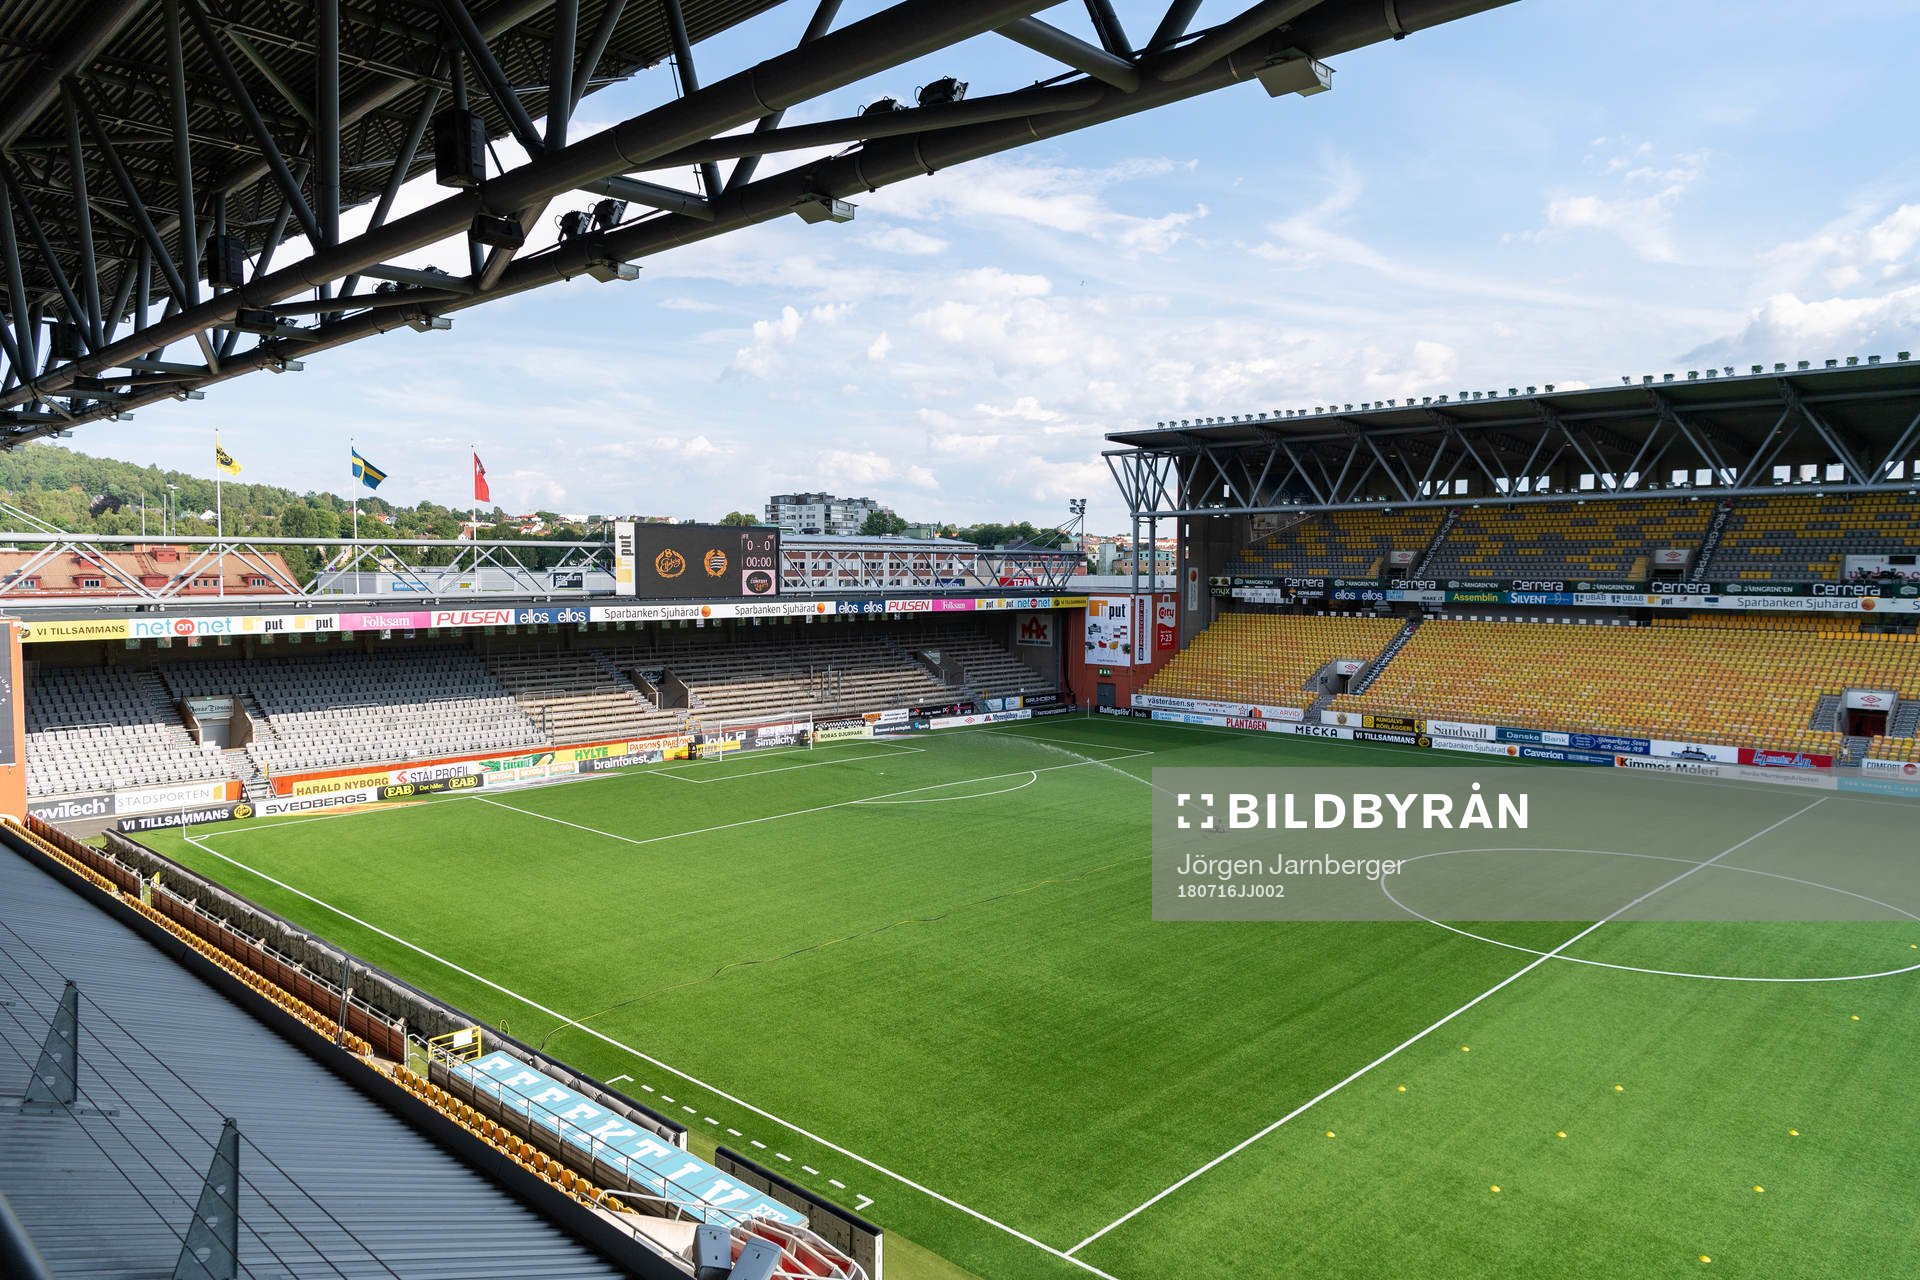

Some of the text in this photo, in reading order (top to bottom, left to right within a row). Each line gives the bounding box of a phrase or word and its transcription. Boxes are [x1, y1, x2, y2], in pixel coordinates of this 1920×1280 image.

[747, 541, 753, 551] 0
[764, 541, 770, 551] 0
[746, 557, 772, 567] 00:00
[1211, 587, 1230, 596] onyx
[1335, 589, 1356, 600] ellos
[1362, 590, 1383, 601] ellos
[1453, 592, 1499, 602] Assemblin
[1510, 592, 1547, 604] SILVENT
[735, 603, 816, 616] Sparbanken Sjuhärad
[838, 600, 883, 614] ellos ellos
[887, 600, 930, 612] PULSEN
[1737, 597, 1858, 610] Sparbanken Sjuhärad
[436, 610, 510, 626] PULSEN
[519, 607, 586, 624] ellos ellos
[604, 606, 699, 620] Sparbanken Sjuhärad
[362, 614, 411, 627] Folksam
[37, 624, 125, 635] VI TILLSAMMANS
[1147, 696, 1195, 708] västeråsen.se
[1226, 717, 1267, 731] PLANTAGEN
[1295, 725, 1338, 738] MECKA
[1434, 723, 1487, 739] Sandwall
[1506, 731, 1540, 741] Danske
[1355, 731, 1416, 745] VI TILLSAMMANS
[575, 747, 609, 760] HYLTE
[1434, 740, 1506, 754] Sparbanken Sjuhärad
[1523, 748, 1564, 760] Caverion
[593, 753, 651, 770] brainforest.
[1620, 756, 1719, 777] Kimmos Måleri
[1866, 761, 1901, 772] COMFORT
[296, 777, 389, 797] HARALD NYBORG
[387, 785, 413, 797] EAB
[452, 777, 475, 788] EAB
[118, 789, 210, 808] STADSPORTEN
[265, 793, 367, 814] SVEDBERGS
[122, 808, 229, 831] VI TILLSAMMANS
